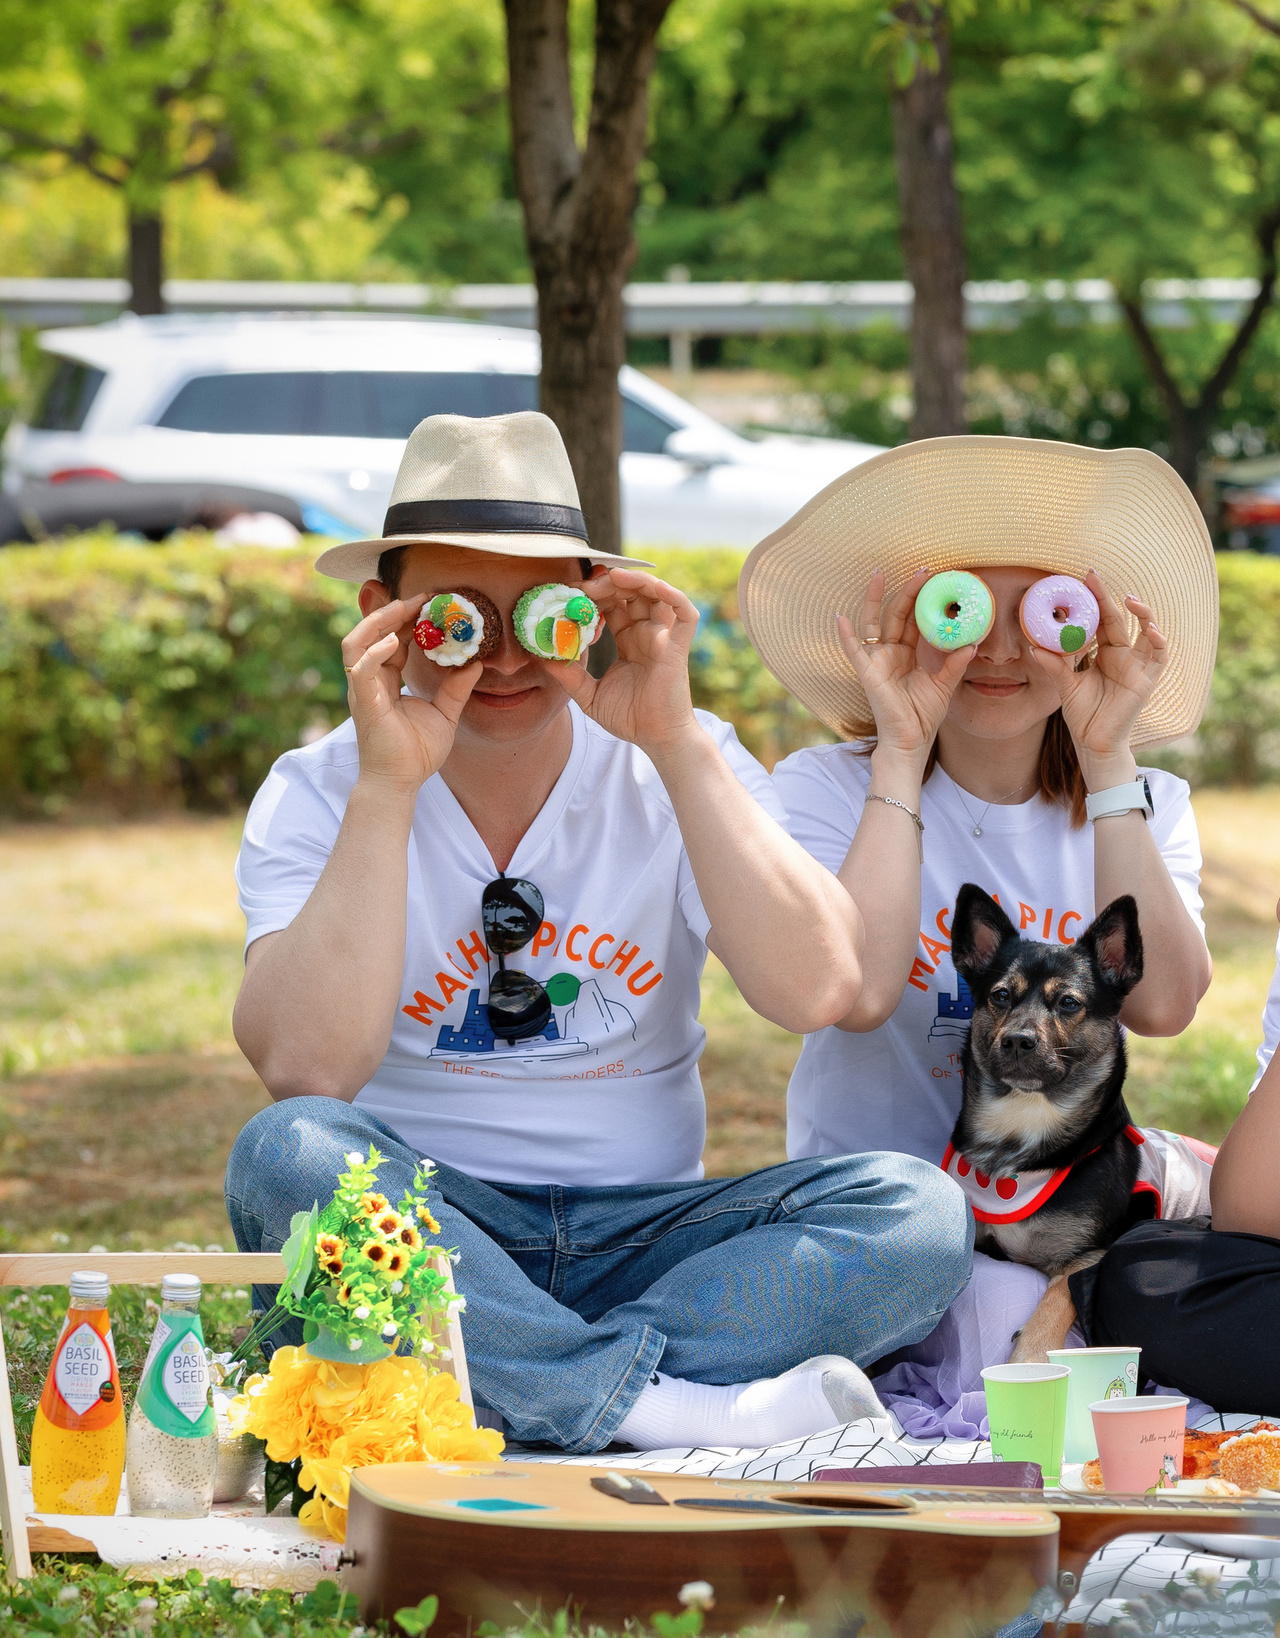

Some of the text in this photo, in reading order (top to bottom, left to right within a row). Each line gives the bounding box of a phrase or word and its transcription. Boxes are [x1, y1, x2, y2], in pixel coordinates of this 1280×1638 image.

[442, 1061, 475, 1076] THE
[931, 1067, 952, 1079] OF
[65, 1346, 103, 1361] BASIL
[64, 1362, 99, 1376] SEED
[173, 1355, 206, 1369] BASIL
[174, 1370, 205, 1384] SEED
[1009, 1429, 1033, 1440] friends
[1140, 1433, 1157, 1444] Hello
[1158, 1435, 1167, 1443] my
